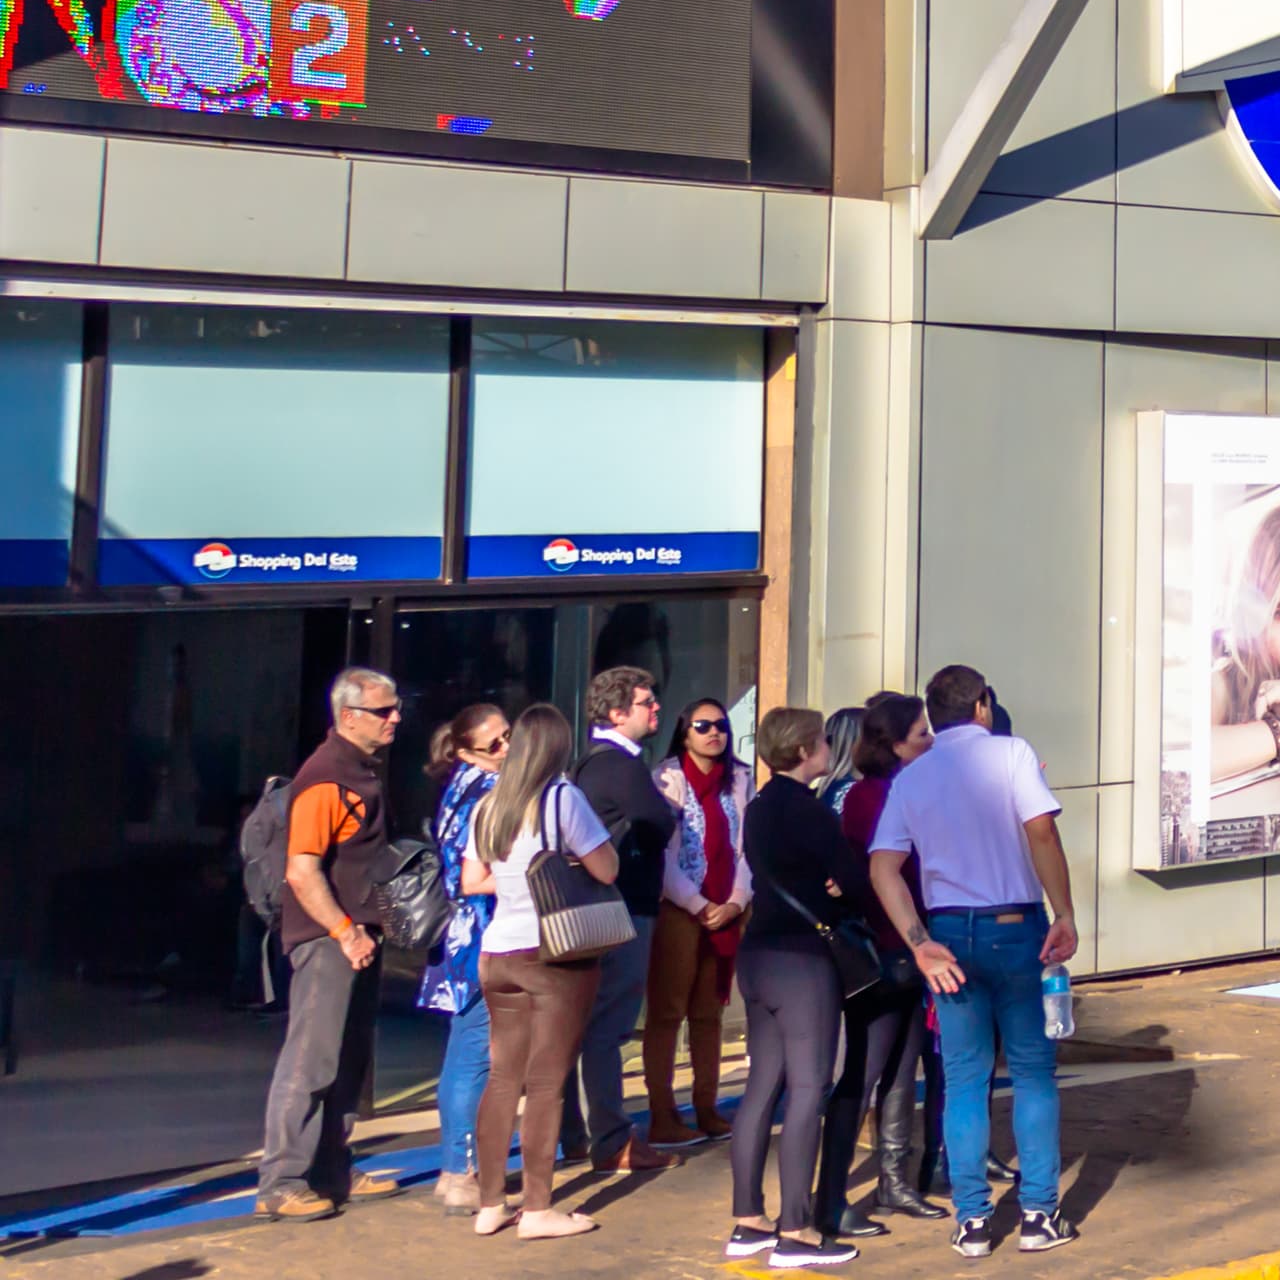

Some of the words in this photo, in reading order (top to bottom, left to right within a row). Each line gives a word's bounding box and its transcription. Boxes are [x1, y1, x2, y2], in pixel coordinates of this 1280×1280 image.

[290, 2, 348, 88] 2
[239, 553, 301, 570] Shopping
[304, 552, 327, 566] Del
[329, 553, 358, 566] Este
[581, 548, 634, 564] Shopping
[636, 548, 655, 560] Del
[657, 548, 681, 561] Este
